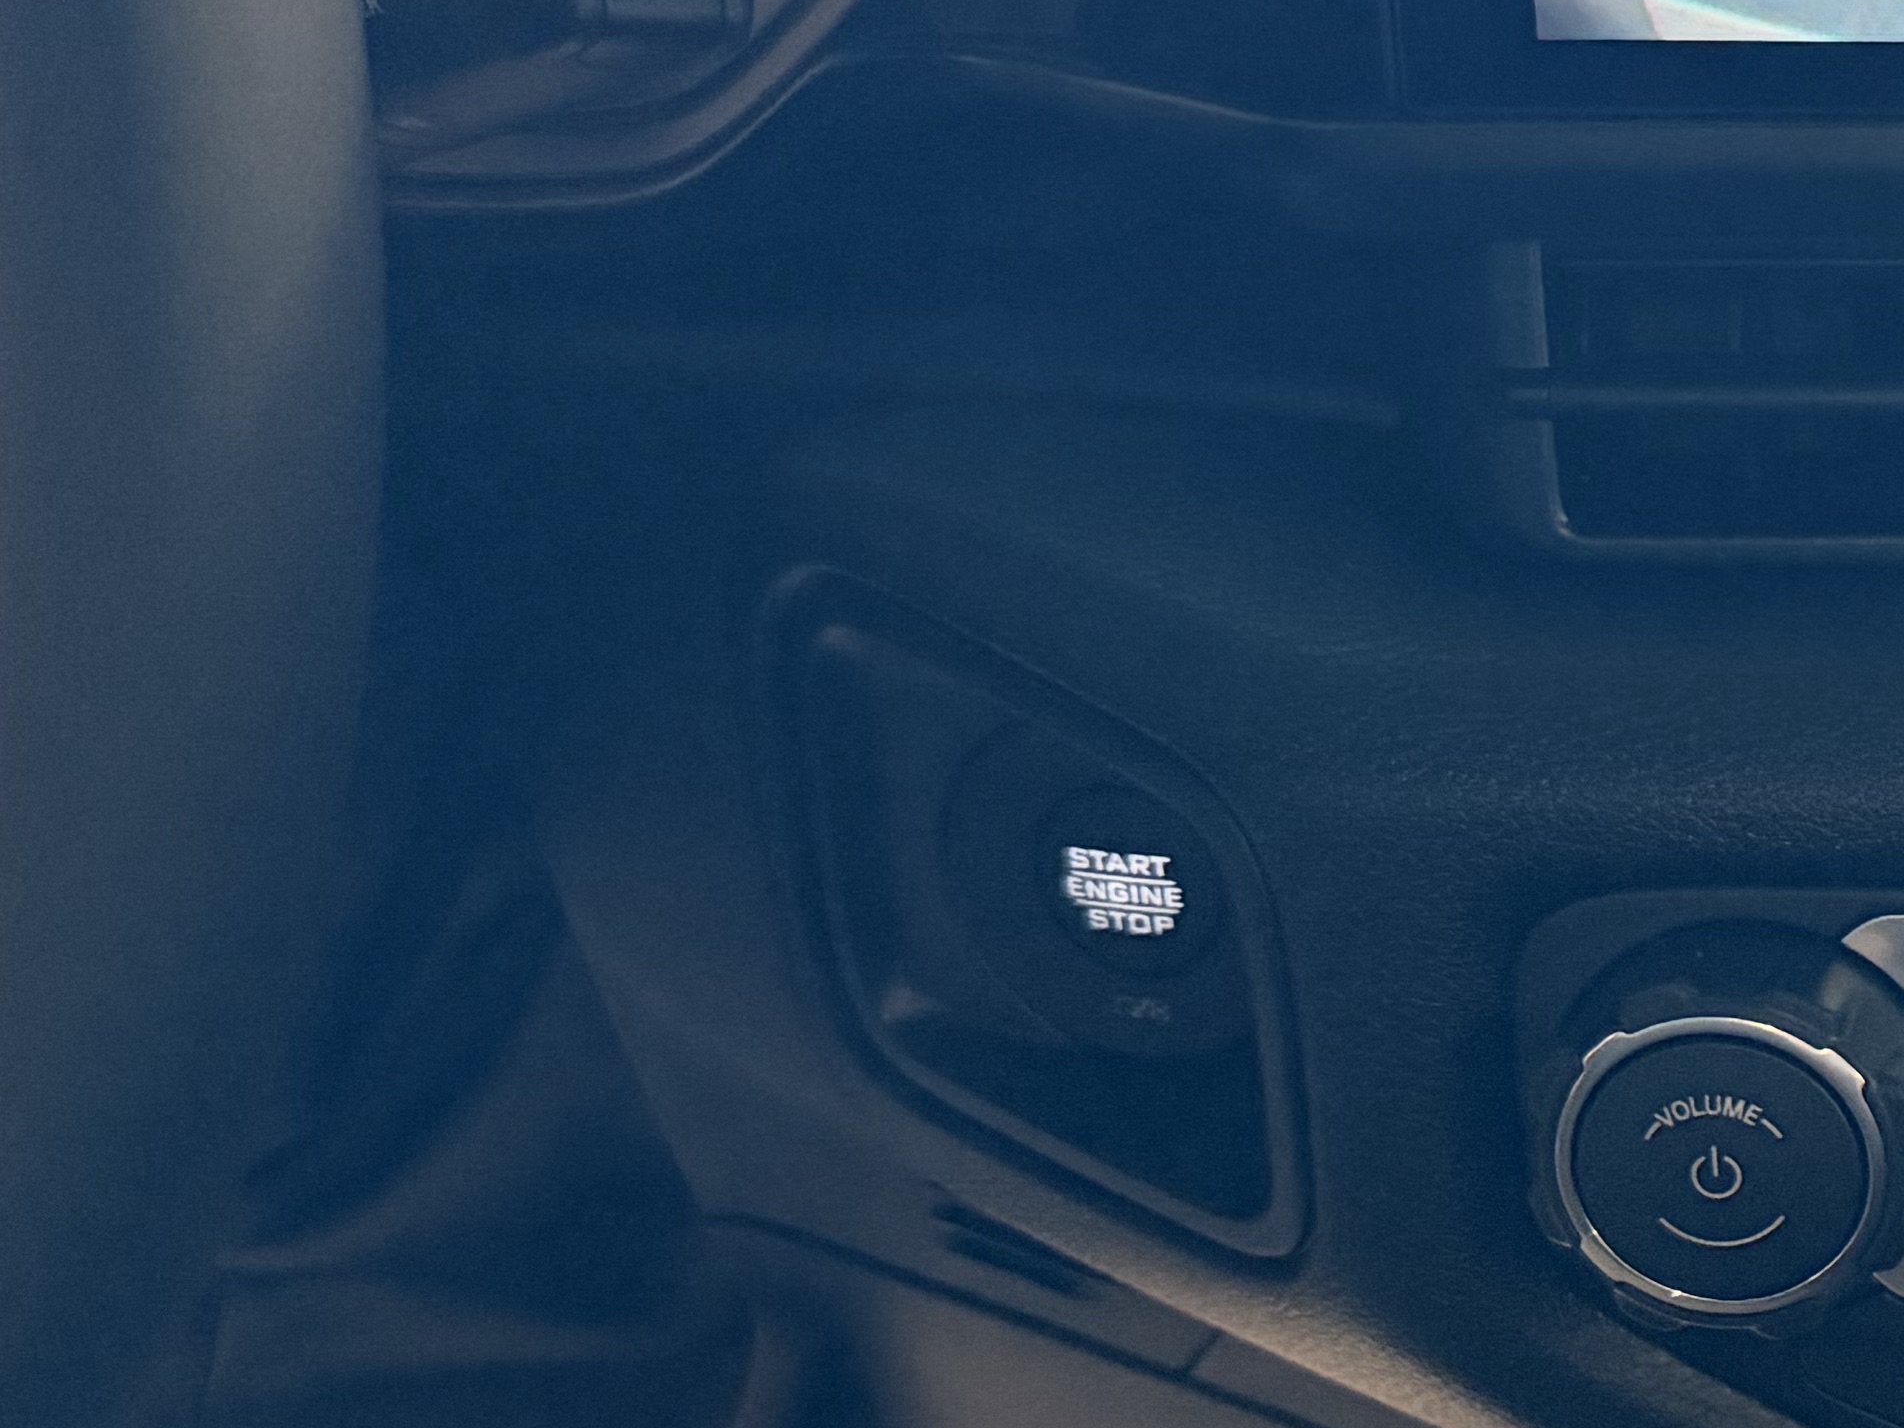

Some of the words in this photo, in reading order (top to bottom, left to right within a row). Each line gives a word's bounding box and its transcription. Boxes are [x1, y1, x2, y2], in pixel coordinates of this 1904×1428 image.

[1063, 846, 1171, 877] START
[1064, 875, 1185, 908] ENGINE
[1086, 908, 1175, 935] STOP
[1653, 1095, 1761, 1129] VOLUME
